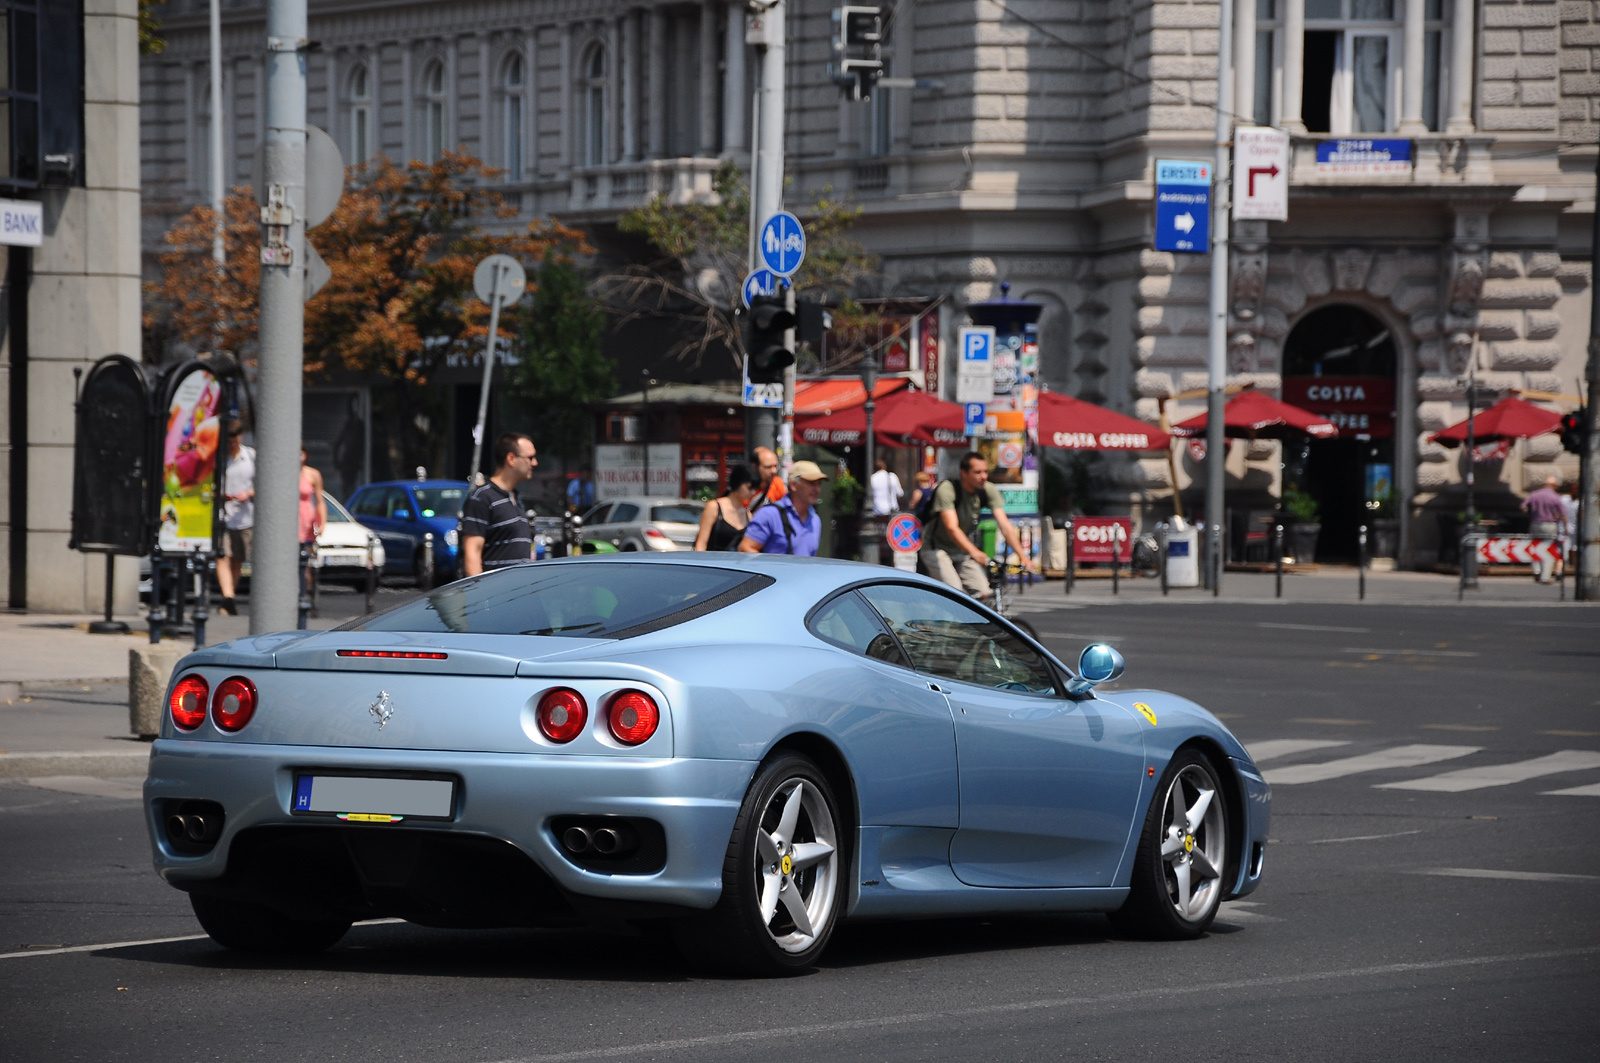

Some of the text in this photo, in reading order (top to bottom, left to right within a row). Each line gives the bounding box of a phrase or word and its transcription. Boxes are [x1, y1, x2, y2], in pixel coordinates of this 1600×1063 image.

[1161, 167, 1198, 179] ERSTE
[4, 211, 39, 234] BANK
[967, 334, 986, 360] P
[1306, 385, 1366, 402] COSTA
[967, 403, 982, 423] P
[1053, 431, 1149, 449] COSTA COFFEE
[1076, 525, 1127, 544] COSTA
[299, 795, 308, 806] H
